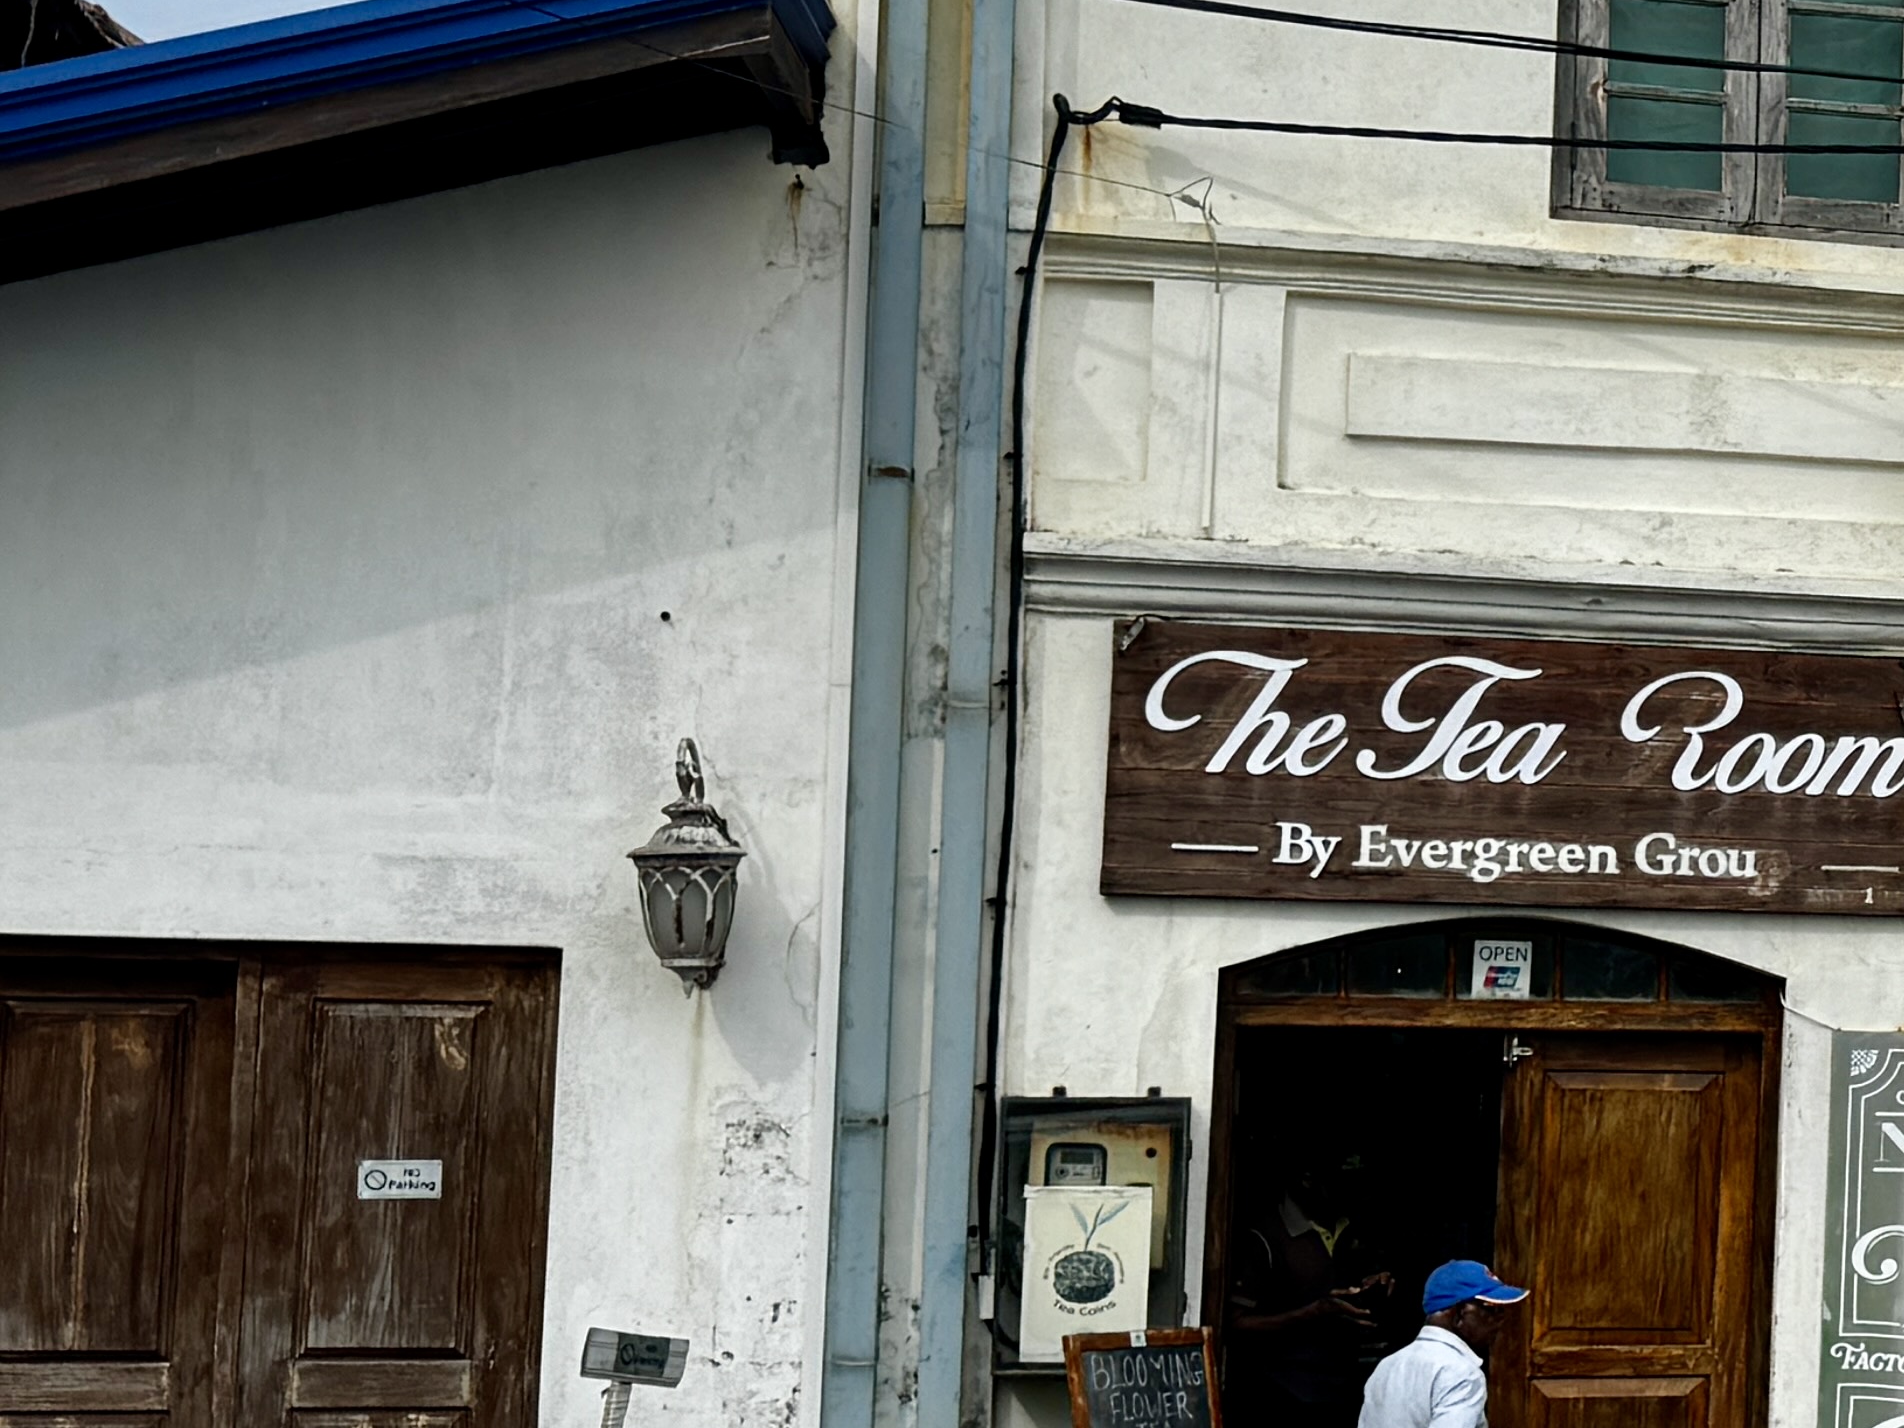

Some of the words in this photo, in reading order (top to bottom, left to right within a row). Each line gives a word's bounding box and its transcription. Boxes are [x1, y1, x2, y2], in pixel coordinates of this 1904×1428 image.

[1144, 649, 1349, 777] The
[1355, 656, 1567, 785] Tea
[1272, 822, 1341, 879] By
[1350, 824, 1619, 882] Evergreen
[1634, 833, 1758, 879] Grou
[1479, 945, 1528, 962] OPEN
[1053, 1298, 1075, 1315] Tea
[1079, 1301, 1117, 1316] Coins
[1110, 1391, 1194, 1424] FLOWER
